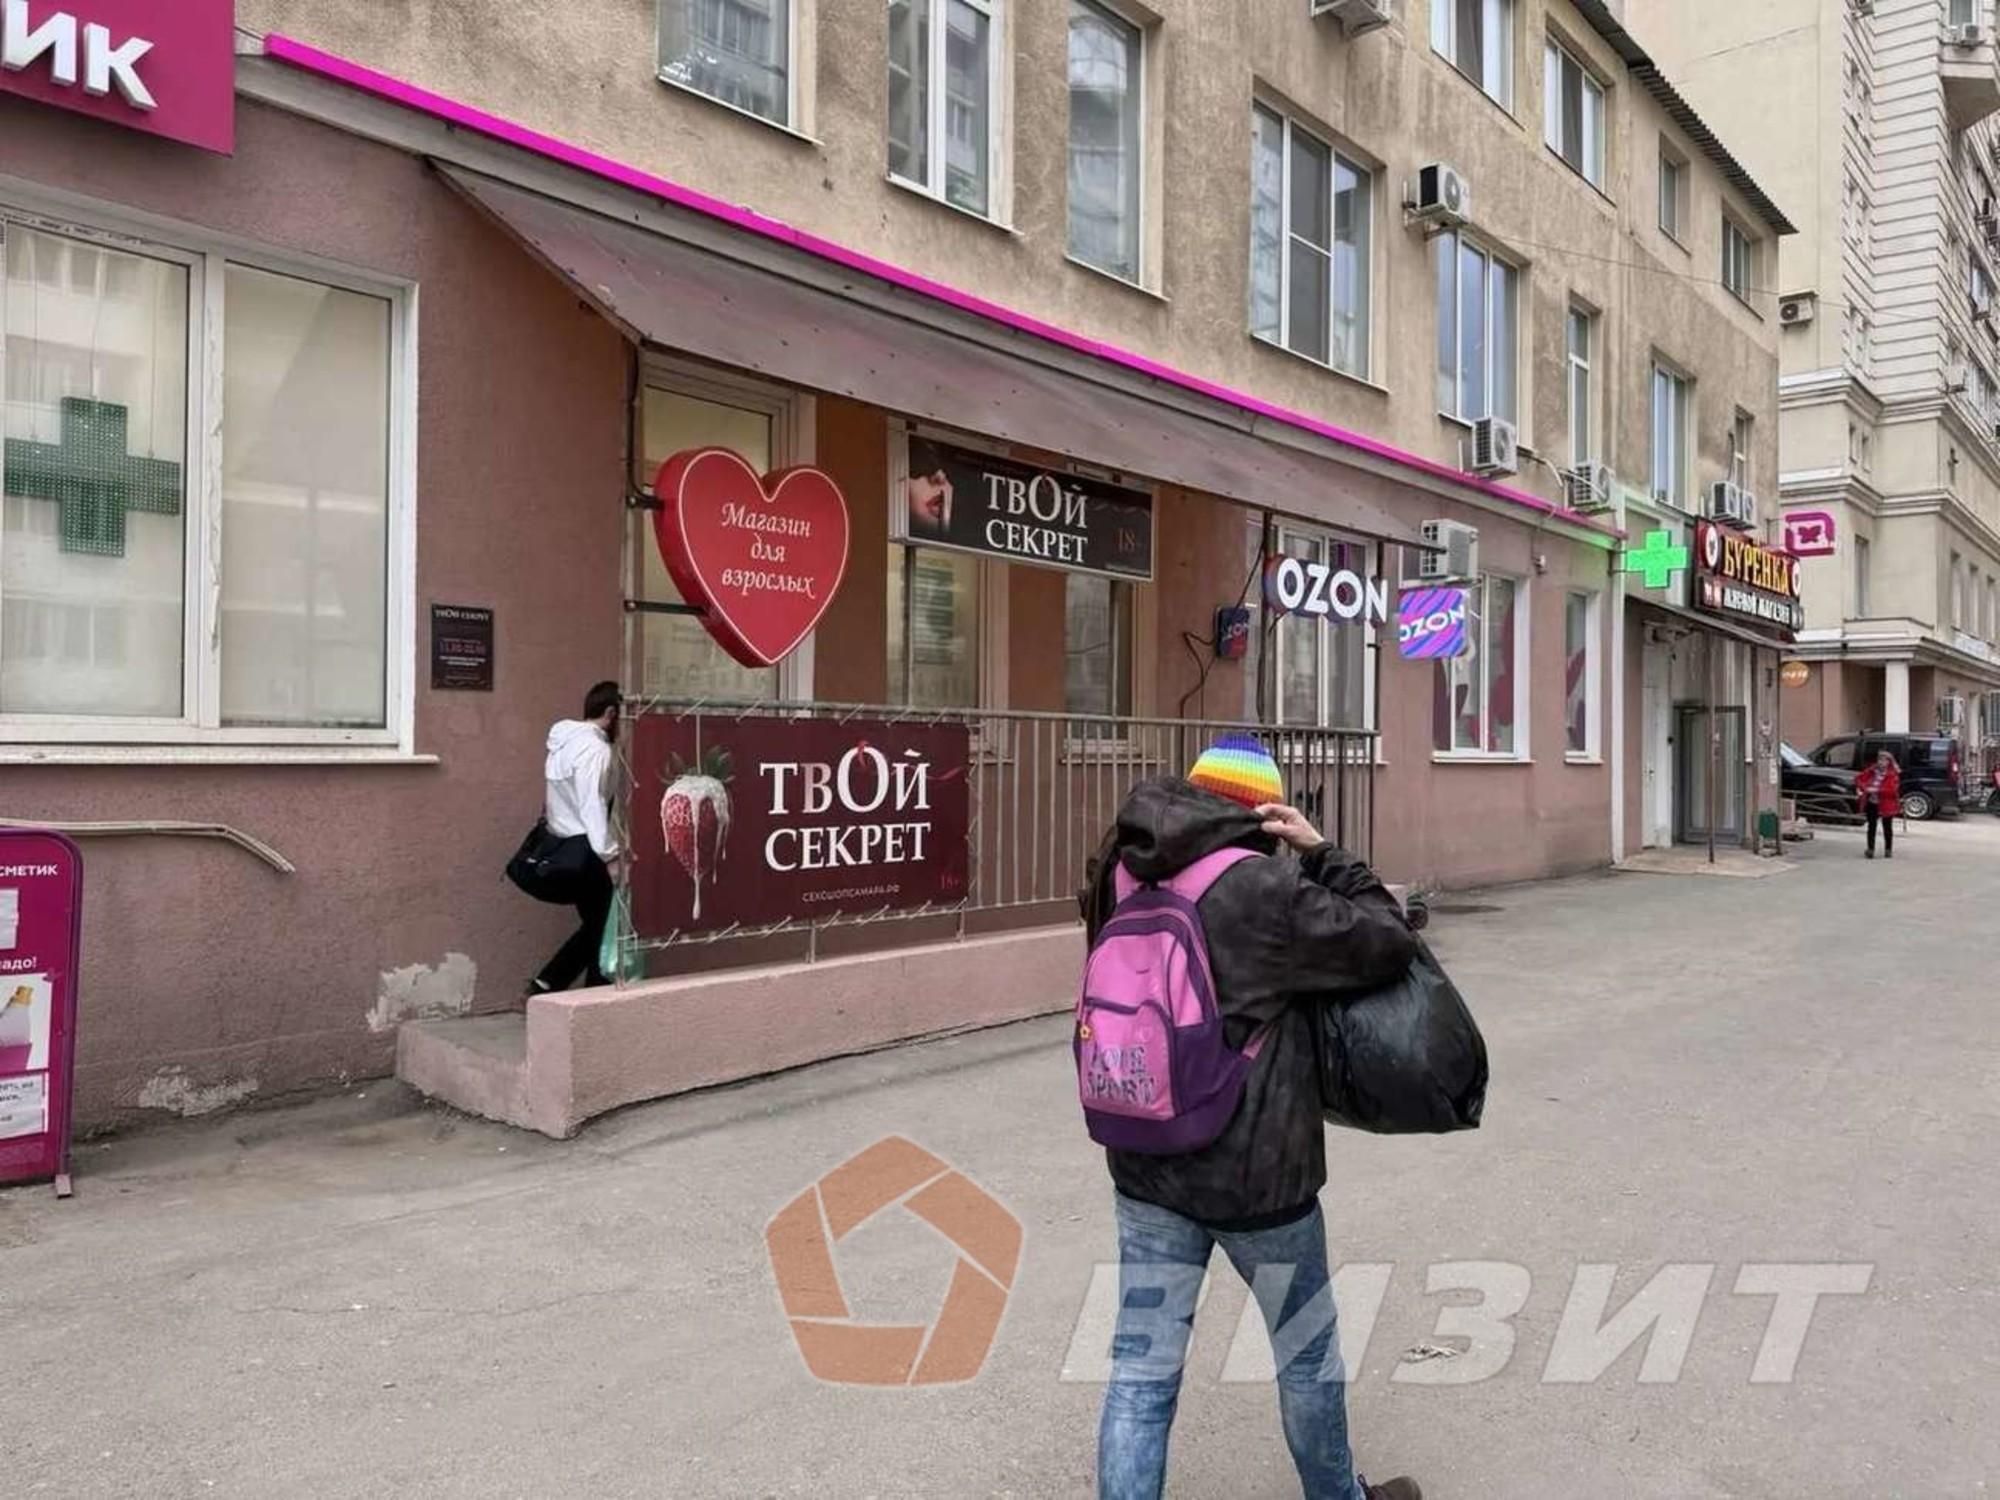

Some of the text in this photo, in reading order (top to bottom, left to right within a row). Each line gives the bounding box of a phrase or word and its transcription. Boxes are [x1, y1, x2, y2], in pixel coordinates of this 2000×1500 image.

[2, 0, 158, 112] ИК
[721, 502, 812, 538] Магазин
[983, 472, 1089, 529] ТВОЙ
[749, 531, 786, 563] для
[985, 518, 1088, 564] СЕКРЕТ
[721, 567, 816, 599] взрослых
[1277, 557, 1388, 624] OZON
[759, 746, 932, 815] ТВОЙ
[764, 822, 932, 872] СЕКРЕТ
[0, 956, 37, 971] адо!
